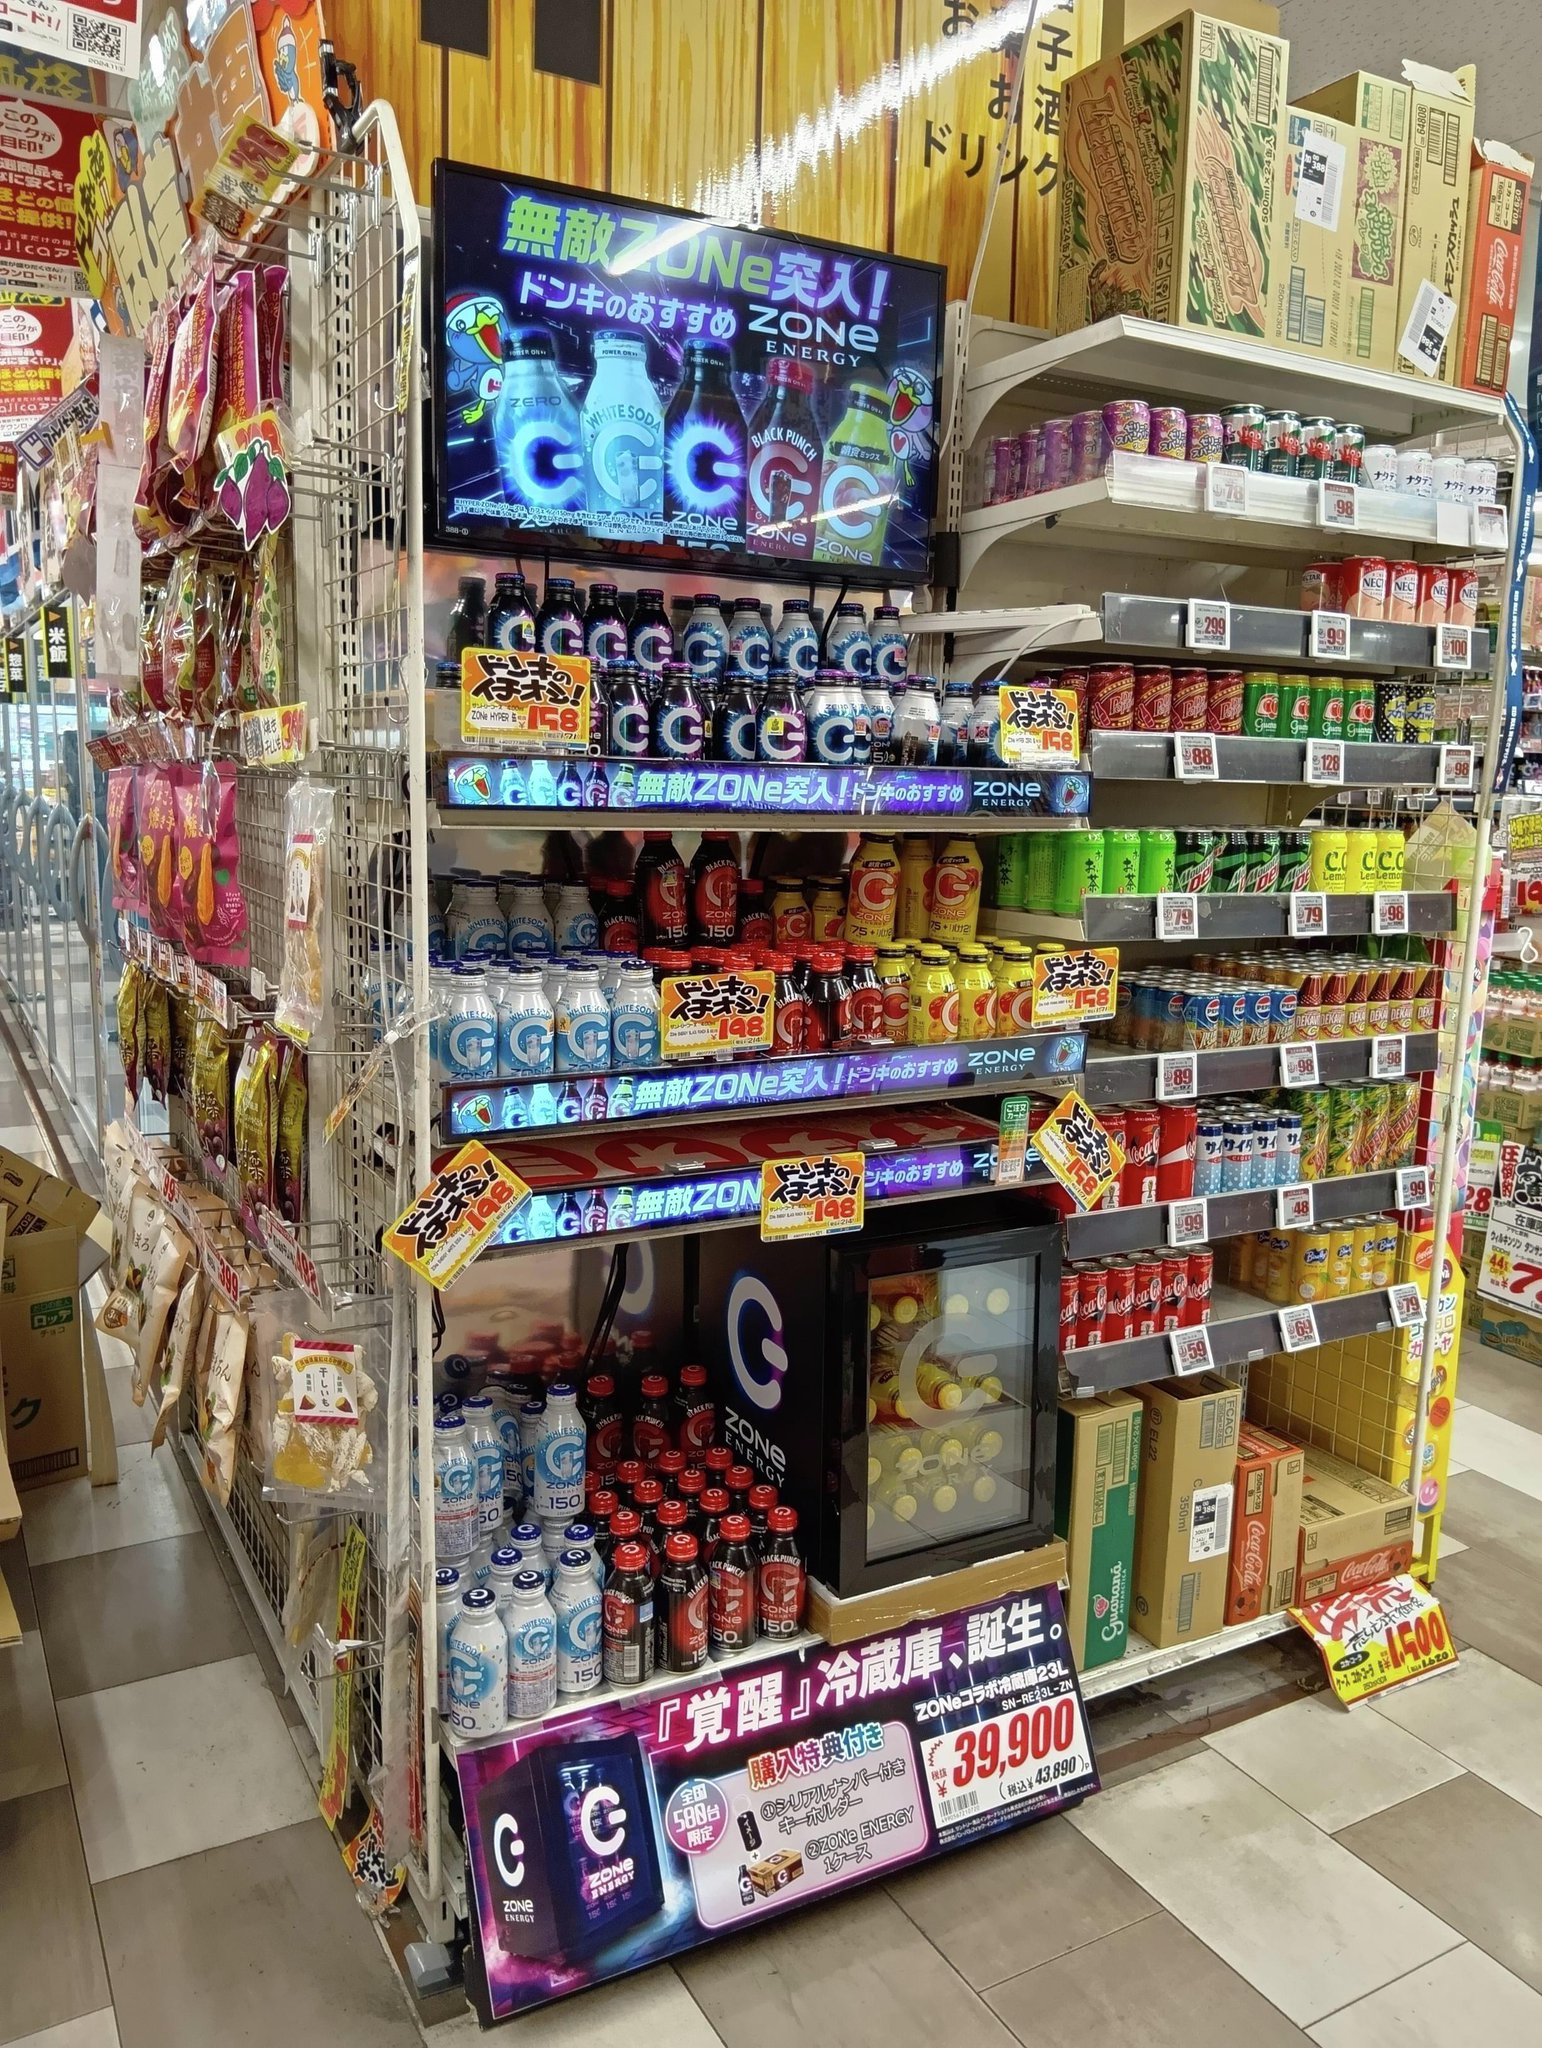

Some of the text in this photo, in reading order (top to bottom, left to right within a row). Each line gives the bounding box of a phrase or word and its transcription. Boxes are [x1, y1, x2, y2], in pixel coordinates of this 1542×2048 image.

[4, 108, 38, 126] この
[0, 121, 55, 143] ークが
[924, 119, 1059, 197] ドリンク
[502, 194, 890, 321] 無敵ZONe突入!
[520, 270, 737, 341] ドンキのおすすめ
[3, 313, 25, 324] この
[766, 340, 861, 369] ENERGY
[509, 396, 562, 408] ZERO
[586, 404, 662, 434] WHITE SODA
[751, 427, 818, 462] BLACK PUNCH
[1336, 499, 1354, 515] 98
[1204, 616, 1226, 636] 299
[1326, 627, 1346, 646] 99
[48, 626, 68, 663] 米飯
[1450, 639, 1468, 656] 100
[8, 653, 24, 683] 惣菜
[491, 712, 511, 722] HYPER
[527, 705, 580, 733] 158
[1042, 731, 1074, 752] 158
[1192, 747, 1213, 766] 88
[1321, 754, 1340, 772] 128
[1454, 762, 1470, 776] 98
[635, 770, 849, 807] 無敵ZONe突入!
[851, 780, 964, 804] ドンキのおすすめ
[982, 798, 1032, 807] ENERGY
[1172, 909, 1194, 926] 79
[1304, 906, 1322, 923] 79
[1387, 905, 1404, 921] 98
[707, 924, 735, 938] 150
[1074, 988, 1110, 1010] 158
[718, 1015, 765, 1041] 198
[976, 1062, 1026, 1075] ENERGY
[1298, 1059, 1313, 1074] 98
[1387, 1051, 1402, 1065] 98
[847, 1058, 959, 1086] ドンキのおすすめ
[1173, 1068, 1193, 1086] 89
[634, 1062, 844, 1111] 無敵ZONe突入!
[1007, 1111, 1026, 1121] カード
[1409, 1181, 1425, 1197] 99
[465, 1179, 515, 1232] 198
[813, 1199, 857, 1224] 198
[1293, 1200, 1310, 1216] 48
[1184, 1214, 1204, 1232] 99
[1403, 1296, 1420, 1313] 79
[33, 1309, 72, 1328] ロッテ
[1295, 1319, 1313, 1338] 69
[1188, 1341, 1207, 1359] 59
[319, 1366, 330, 1408] 干しいも
[1225, 1399, 1236, 1443] FCACL
[725, 1430, 785, 1489] ENERGY
[1101, 1559, 1123, 1643] Guaraná
[658, 1598, 1063, 1753] 『覚醒』冷蔵庫、誕生。
[913, 1660, 1069, 1723] ZONeコラボ冷蔵庫23L
[953, 1697, 1075, 1788] 39,900
[748, 1721, 885, 1792] 購入特典付き
[930, 1767, 948, 1782] 税抜
[680, 1783, 708, 1808] 全国
[778, 1796, 864, 1836] キーホルダー
[859, 1806, 915, 1843] ENERGY
[686, 1826, 716, 1849] 限定
[824, 1844, 873, 1875] 1ケース
[590, 1870, 636, 1901] ENERGY
[504, 1911, 536, 1924] ENERGY
